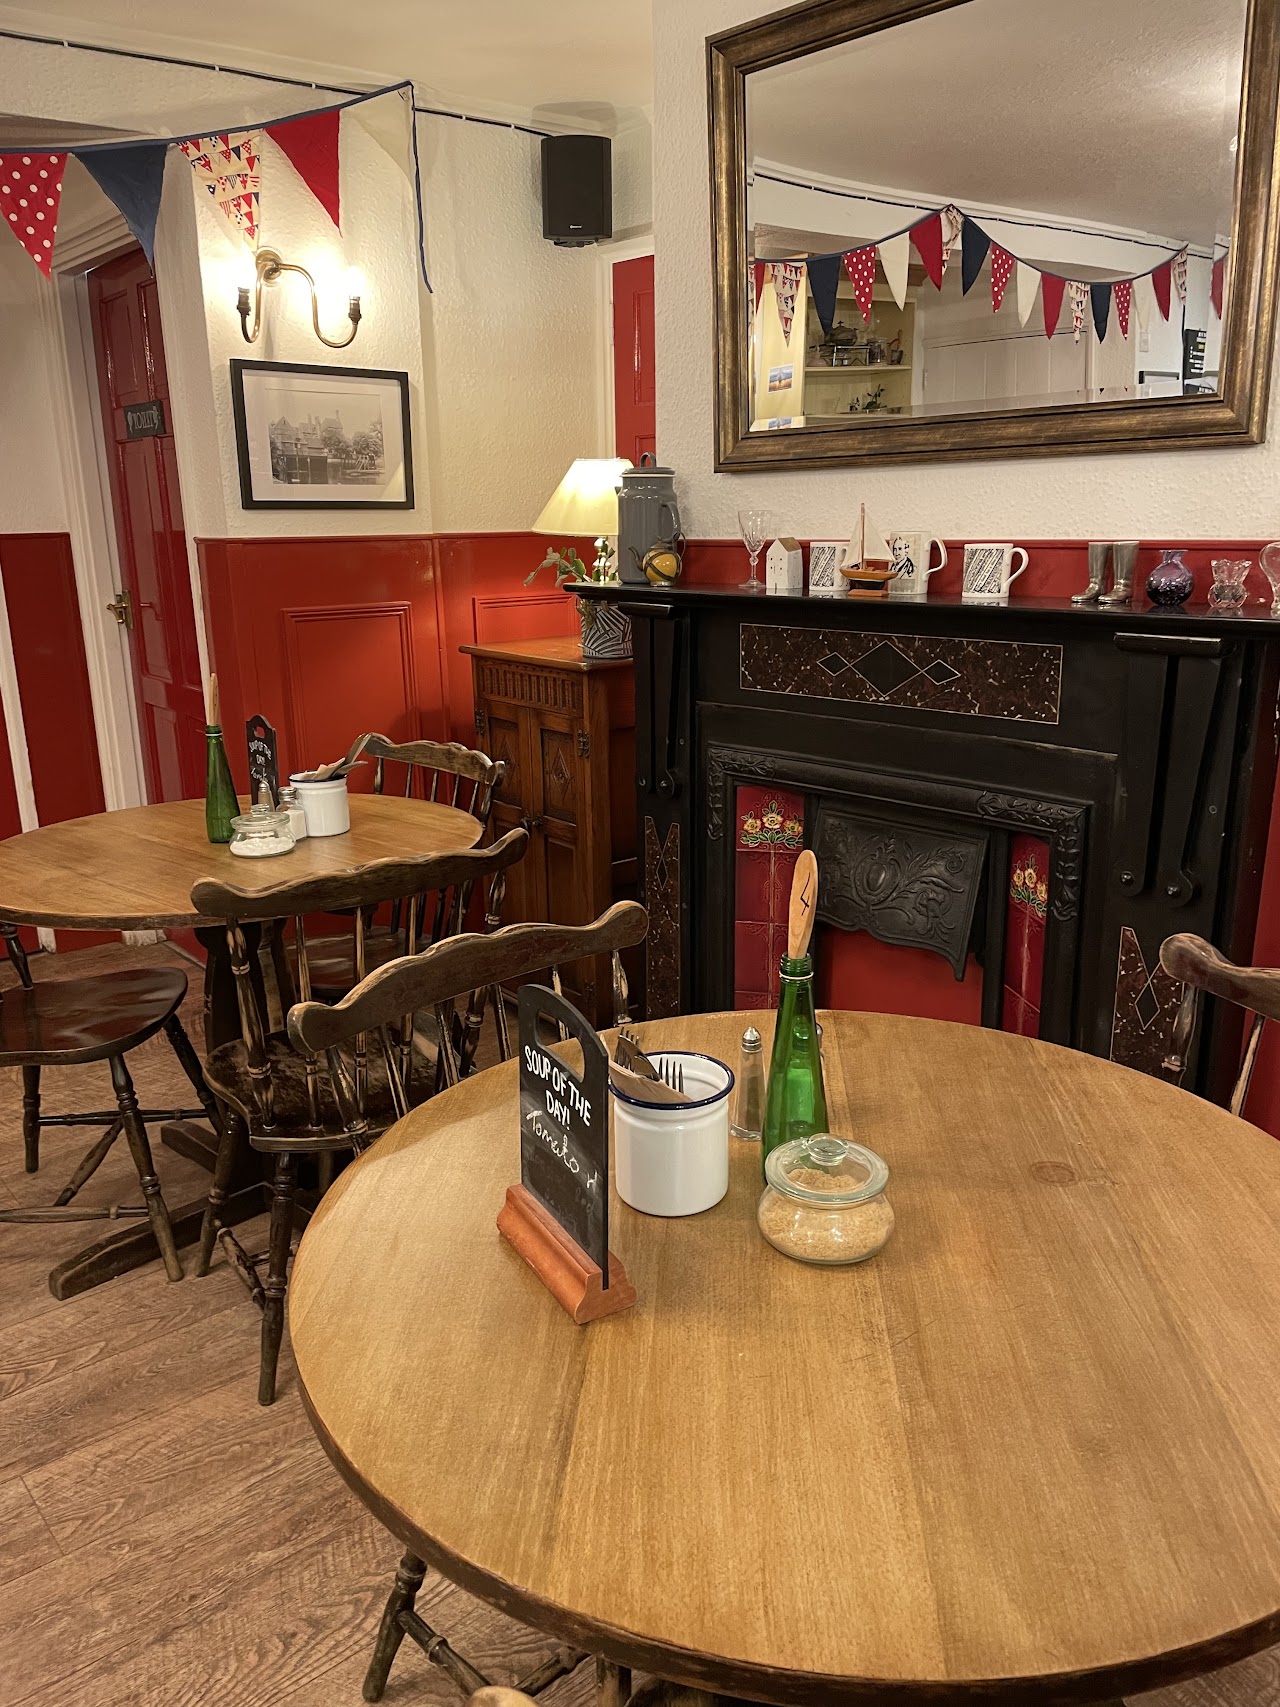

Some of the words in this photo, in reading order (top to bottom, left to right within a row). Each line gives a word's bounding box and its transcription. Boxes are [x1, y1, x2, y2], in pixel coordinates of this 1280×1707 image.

[524, 1045, 551, 1081] SOUP
[552, 1067, 568, 1096] OF
[567, 1080, 592, 1127] THE
[545, 1089, 571, 1131] DAY!
[526, 1110, 580, 1173] Tomato
